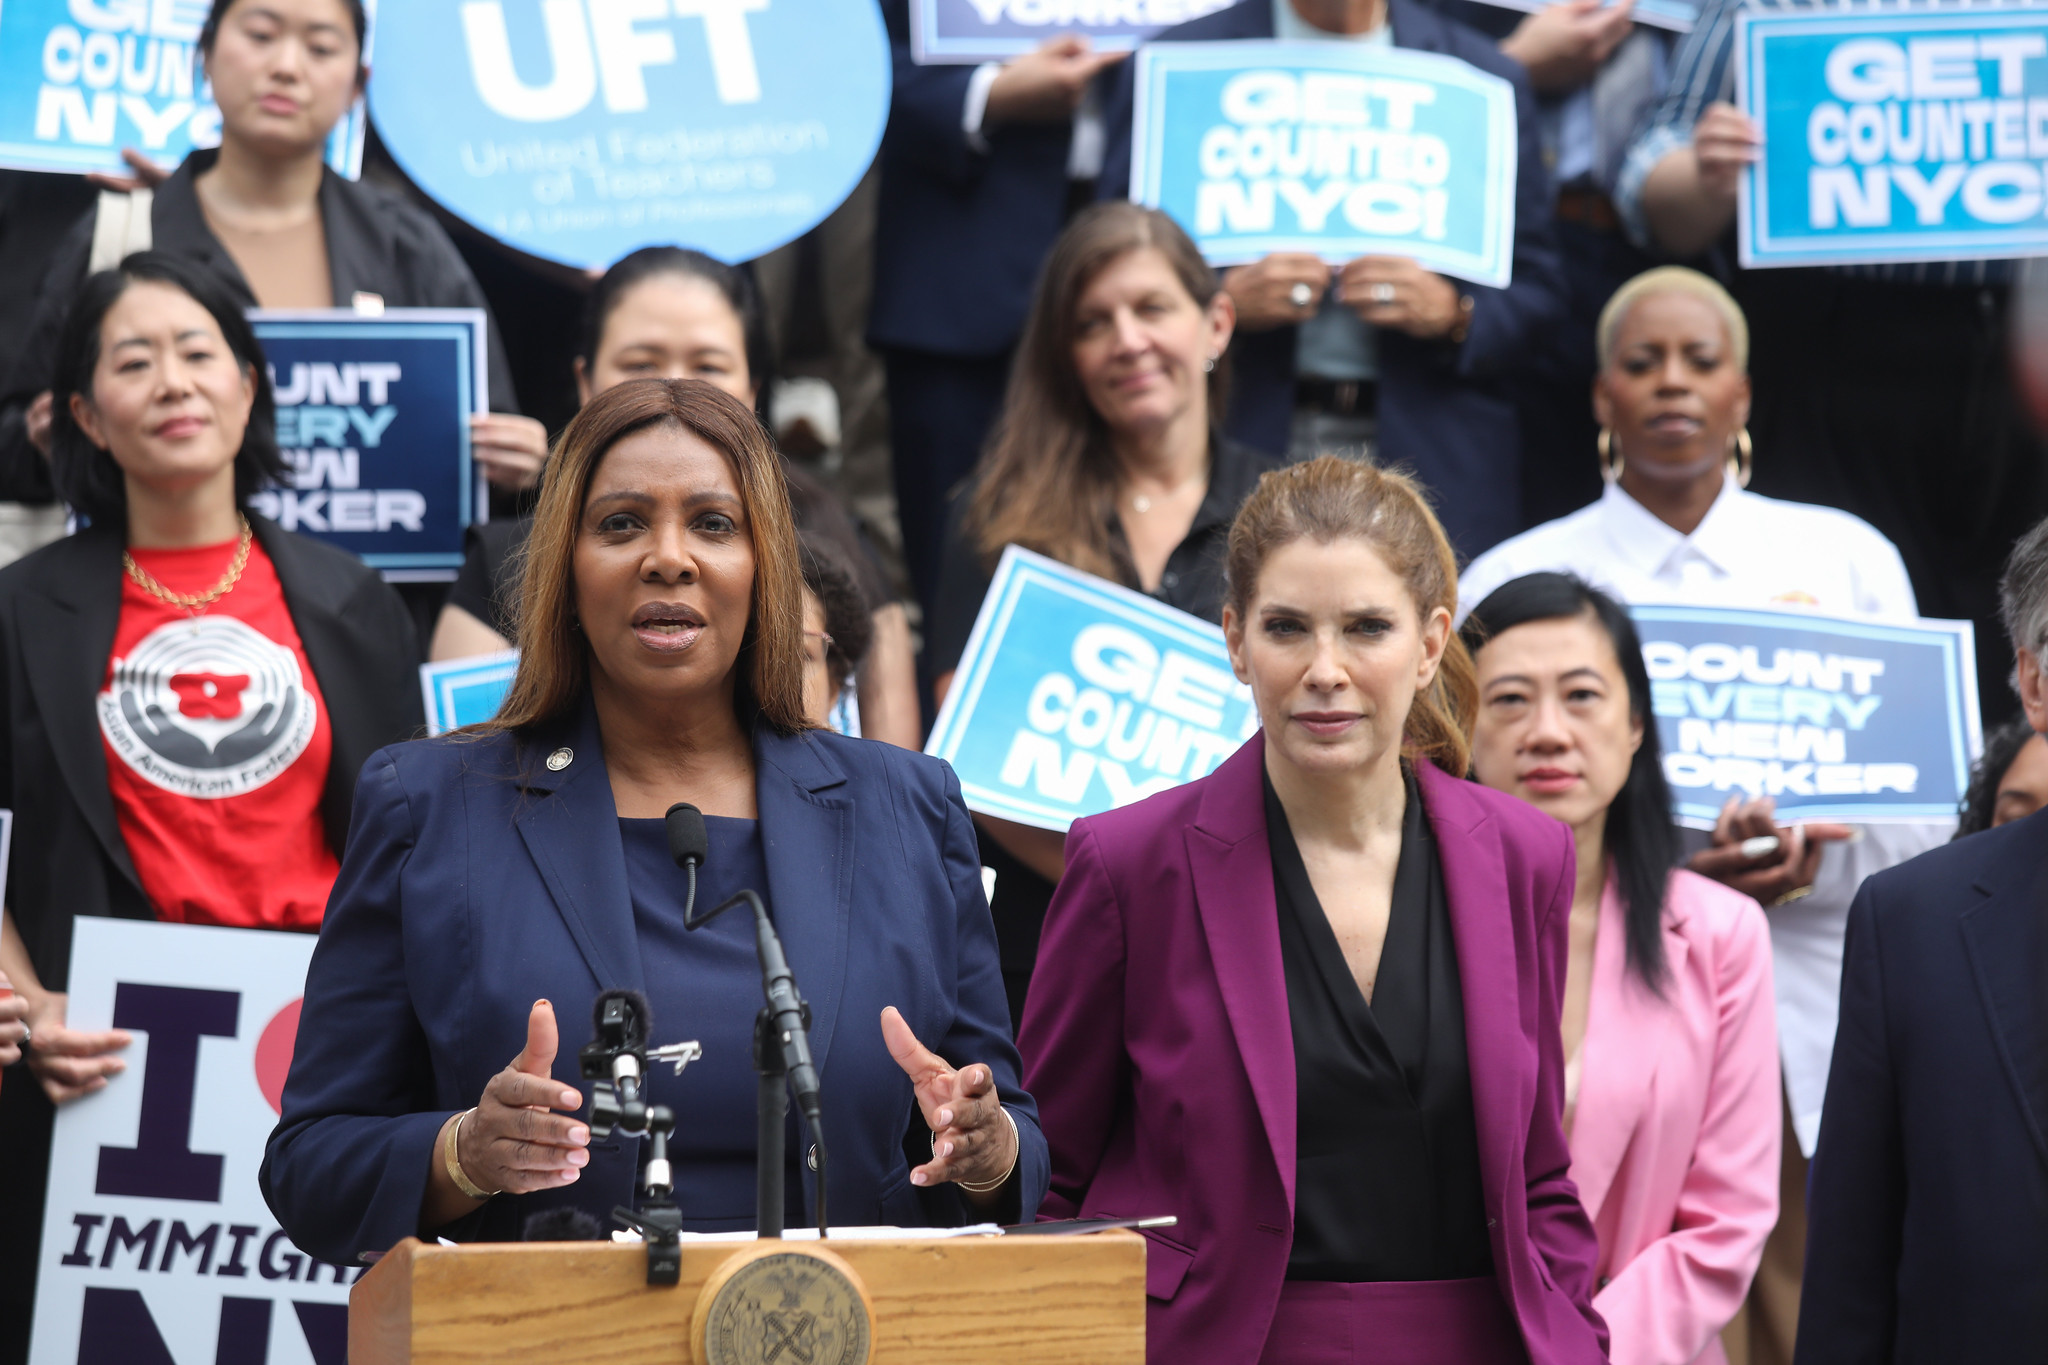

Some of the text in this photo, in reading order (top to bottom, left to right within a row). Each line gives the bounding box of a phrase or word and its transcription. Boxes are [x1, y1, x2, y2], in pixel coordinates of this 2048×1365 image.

[42, 23, 213, 99] COUN
[460, 0, 772, 122] UFT
[1824, 34, 2047, 102] GET
[1221, 70, 1437, 132] GET
[1198, 125, 1451, 187] COUNTED
[1195, 178, 1448, 242] NYC!
[1808, 161, 2048, 229] NYC
[1641, 640, 1885, 695] COUNT
[1027, 671, 1245, 783] COUNT
[1651, 679, 1882, 731] EVERY
[102, 699, 135, 754] Asian
[136, 755, 233, 792] American
[1677, 717, 1847, 763] NEW
[95, 981, 242, 1202] I
[61, 1212, 372, 1285] IMMIG
